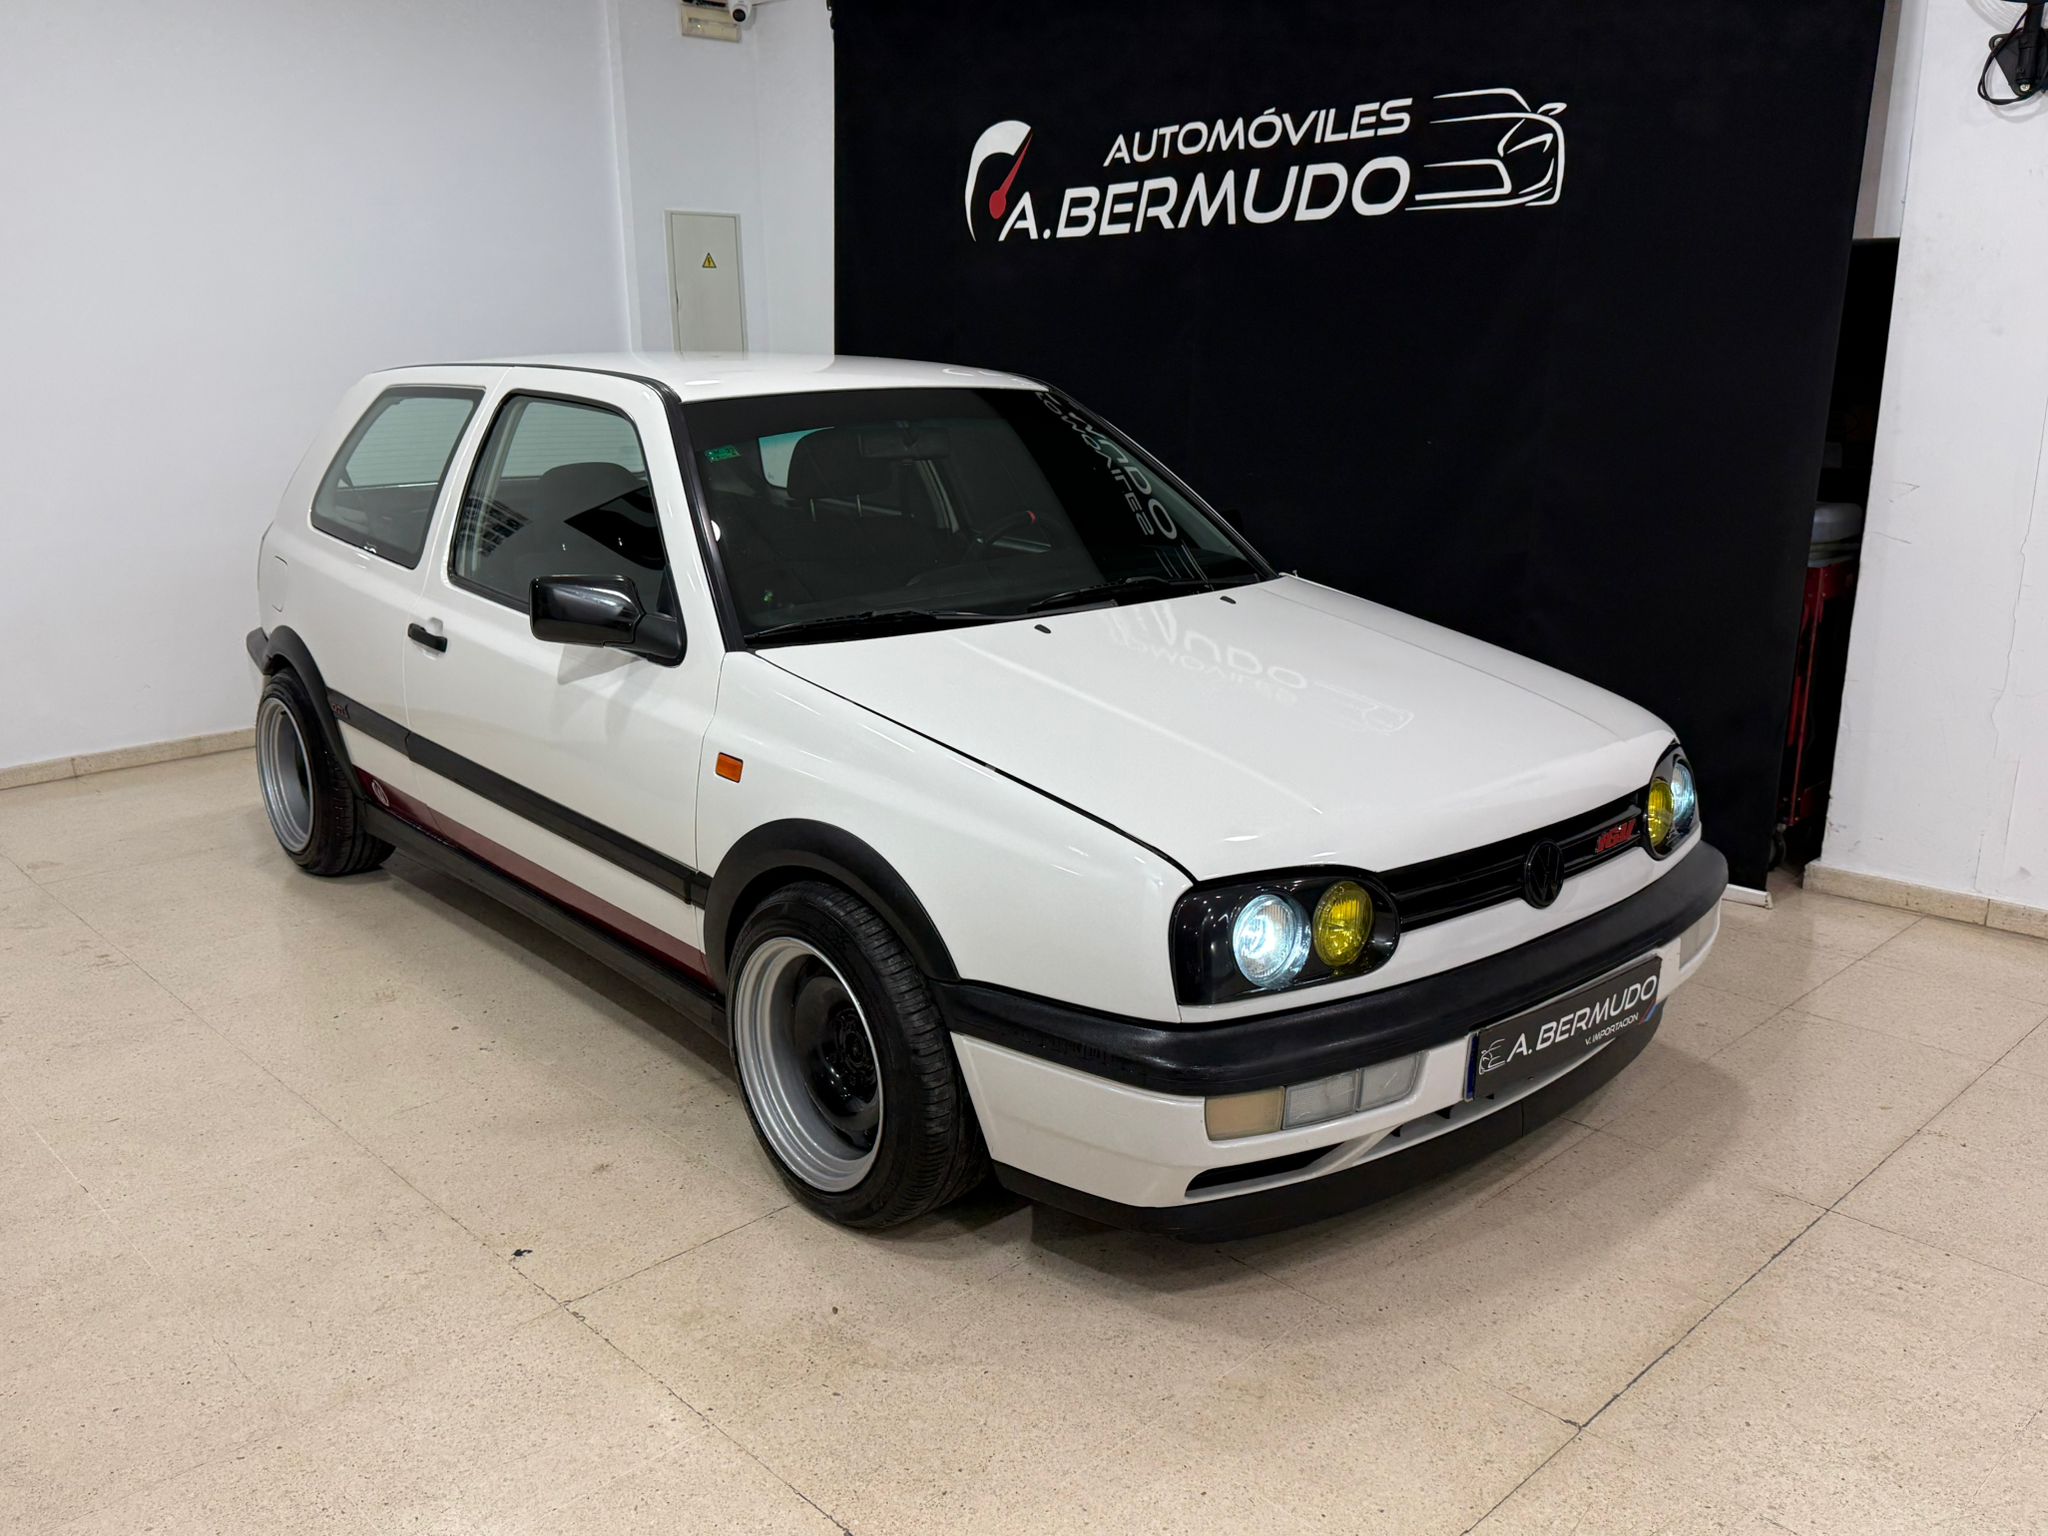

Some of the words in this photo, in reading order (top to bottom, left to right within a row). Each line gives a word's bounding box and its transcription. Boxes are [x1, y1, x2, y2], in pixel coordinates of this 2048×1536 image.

[1103, 98, 1412, 167] AUTOMÓVILES
[999, 156, 1411, 240] A.BERMUDO
[1506, 975, 1658, 1063] A.BERMUDO
